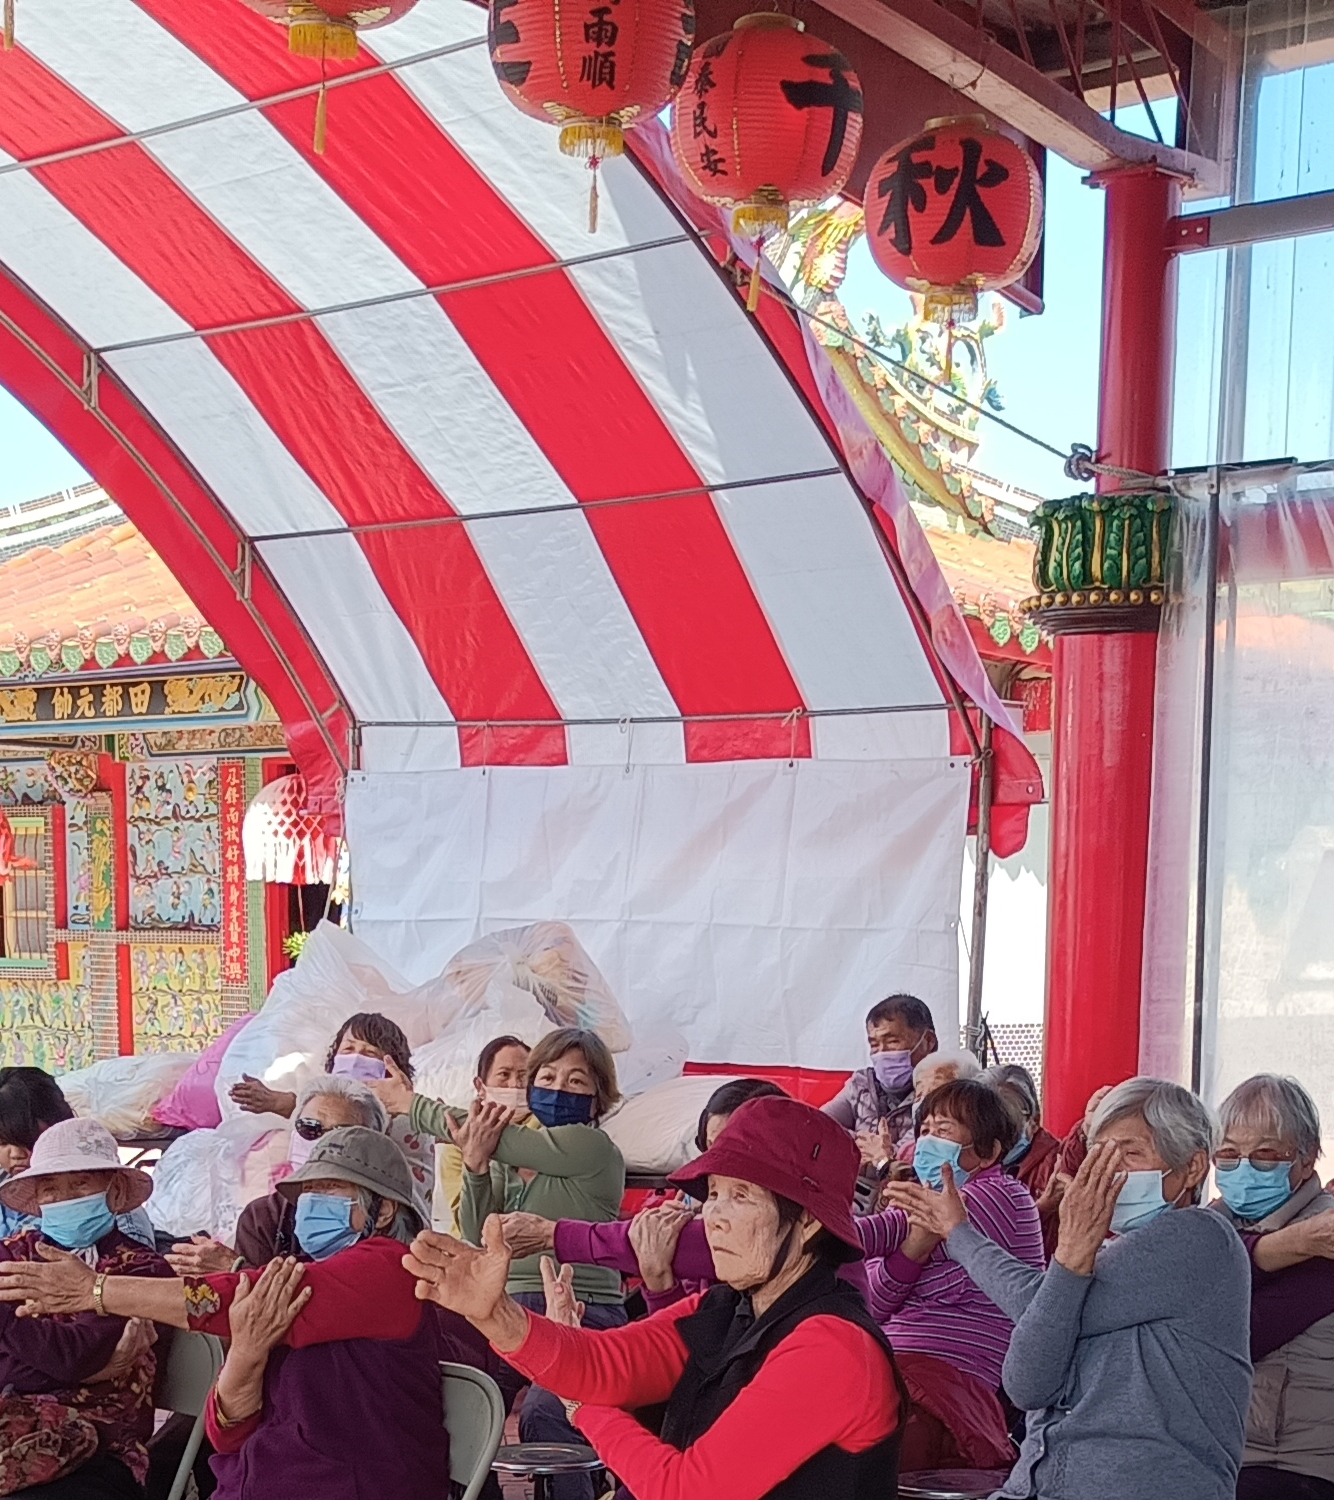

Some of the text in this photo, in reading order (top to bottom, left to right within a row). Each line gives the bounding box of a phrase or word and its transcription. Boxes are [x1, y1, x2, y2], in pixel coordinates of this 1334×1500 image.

[579, 0, 618, 90] 雨順
[780, 53, 863, 177] 千
[877, 135, 1009, 256] 秋
